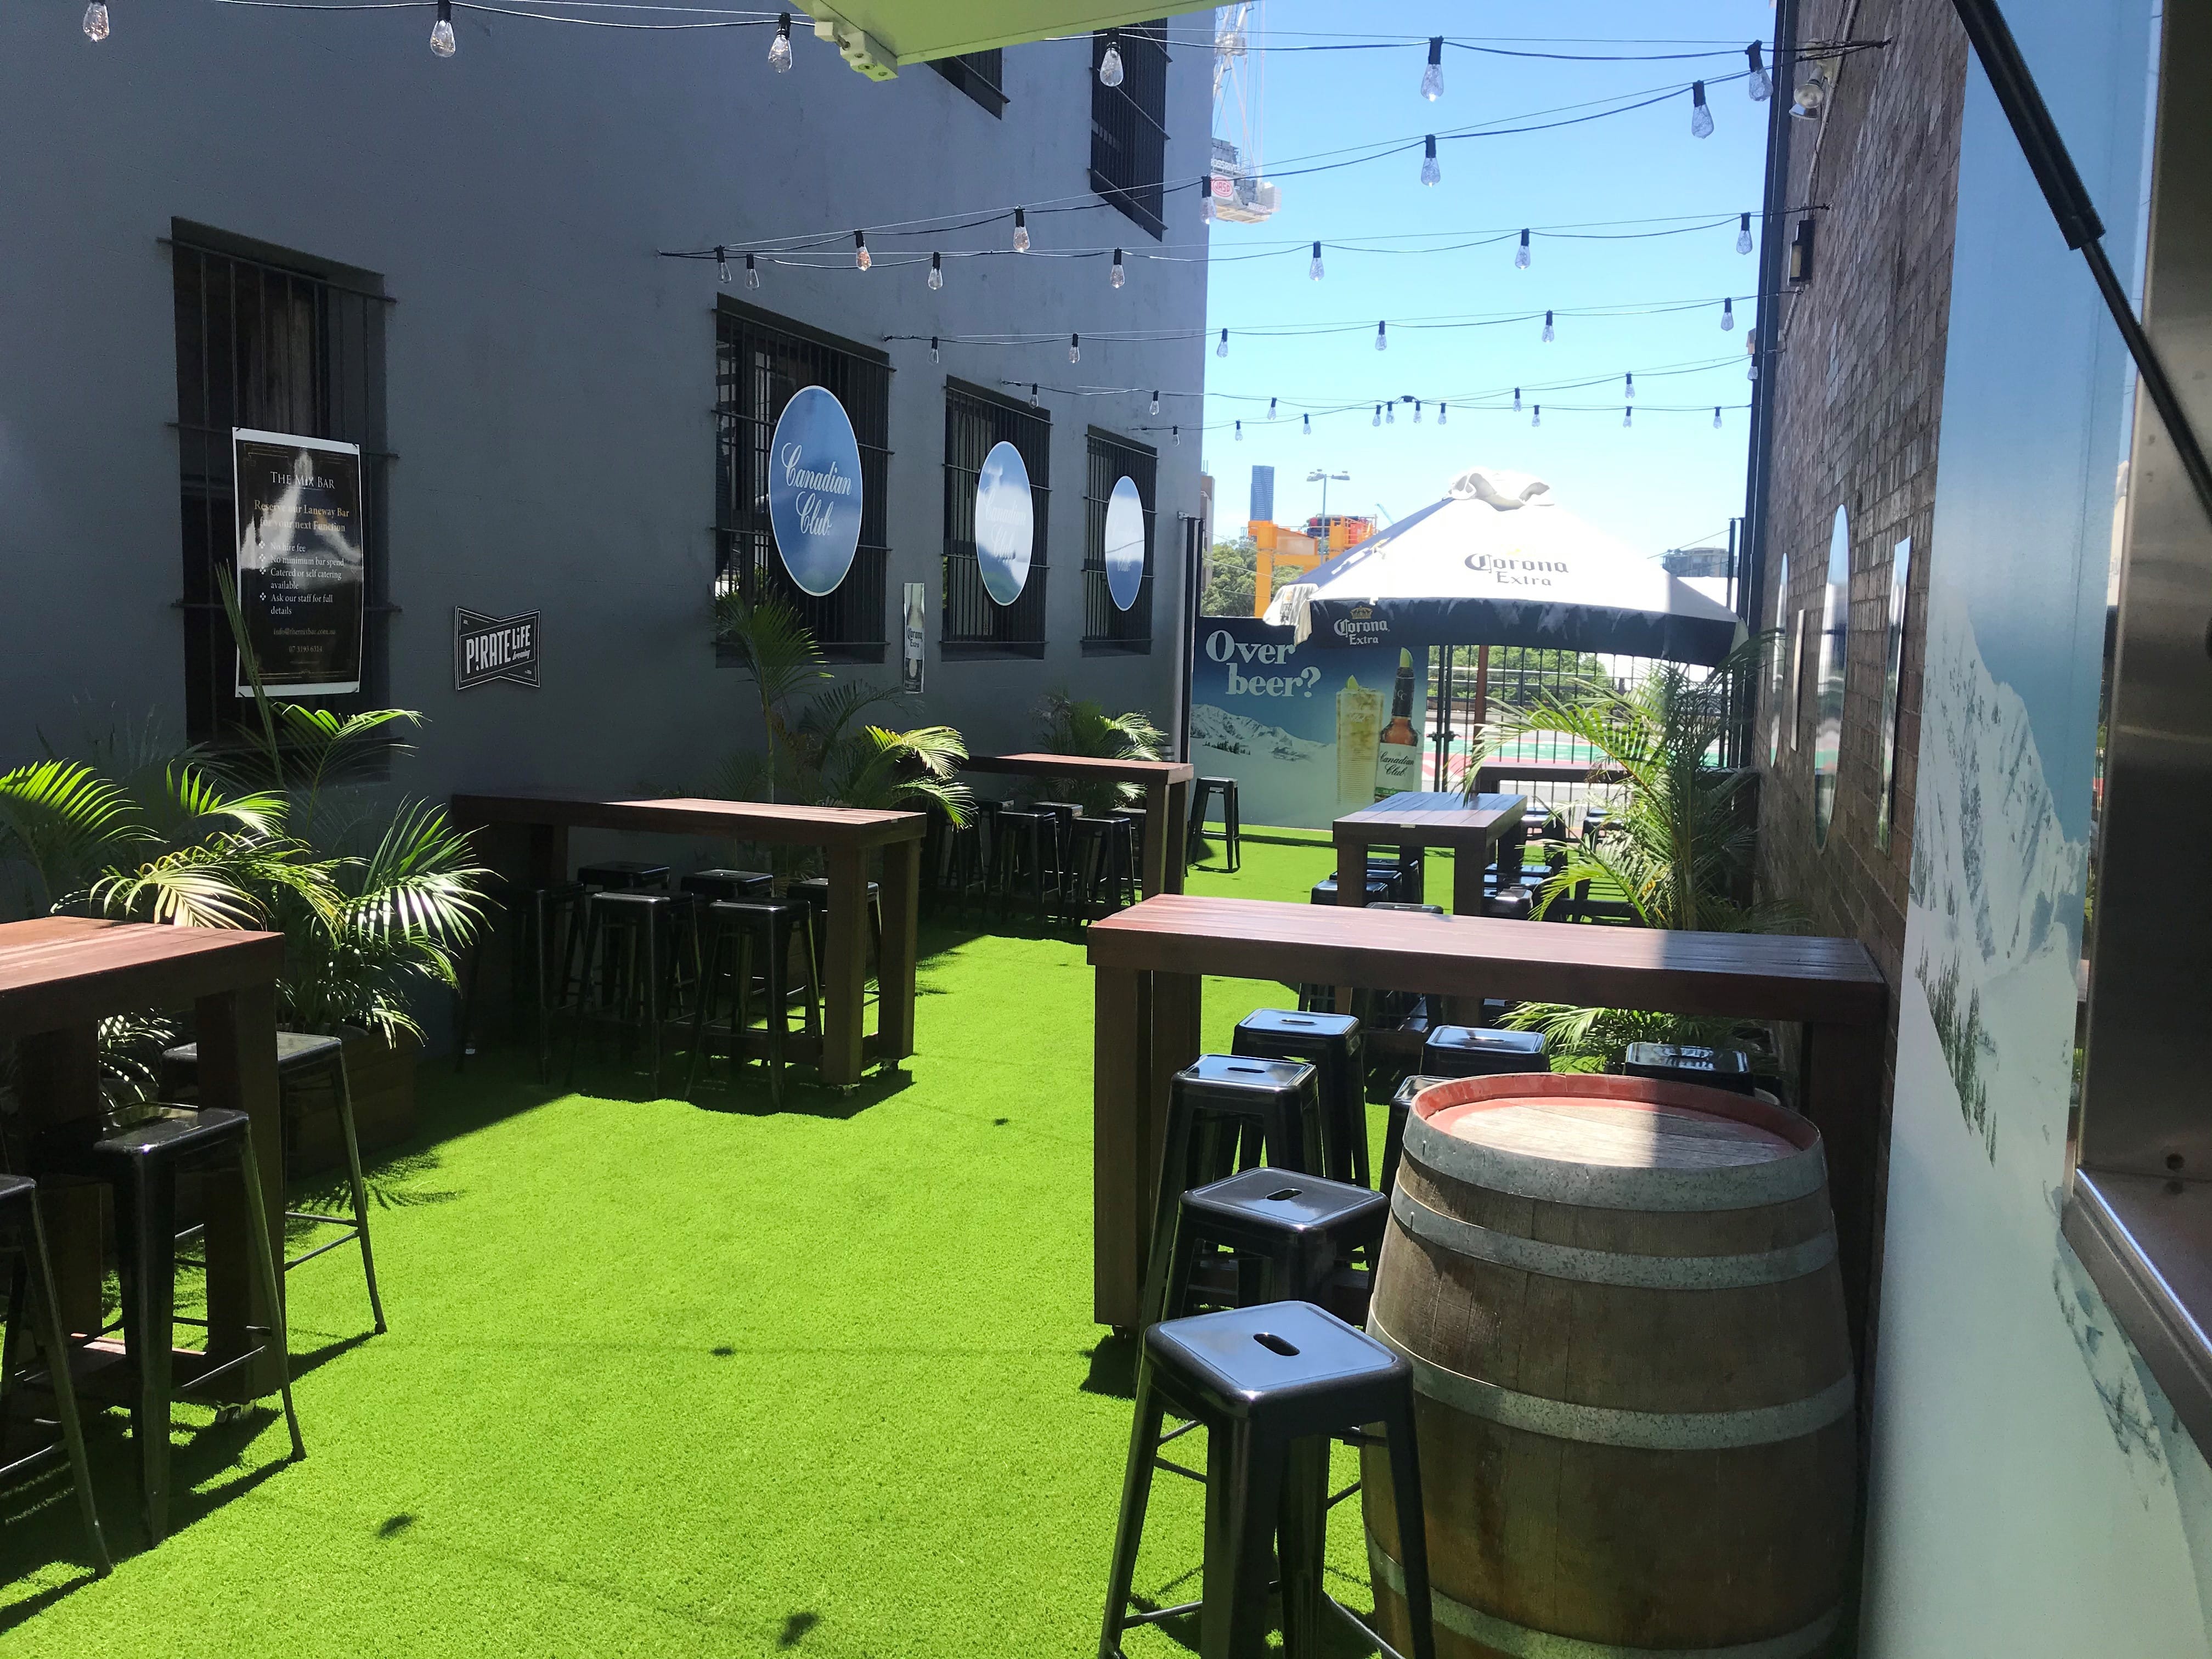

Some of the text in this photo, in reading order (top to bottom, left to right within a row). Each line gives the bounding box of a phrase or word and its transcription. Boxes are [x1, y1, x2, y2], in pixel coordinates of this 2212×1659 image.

[781, 442, 852, 495] Canadian
[270, 471, 335, 489] THE MIX BAR
[254, 499, 285, 512] Reserve
[304, 504, 336, 518] Laneway
[337, 507, 349, 517] Bar
[796, 491, 834, 535] Club
[295, 521, 311, 529] next
[313, 521, 346, 532] Function
[270, 542, 306, 552] No hire fee
[270, 555, 345, 568] No minimum bar spend
[1464, 553, 1569, 573] Corona
[270, 567, 296, 577] Catered
[306, 569, 317, 578] self
[318, 571, 342, 581] catering
[1496, 571, 1552, 586] Extra
[270, 580, 299, 590] available
[270, 594, 284, 602] Ask
[298, 594, 312, 603] staff
[313, 594, 322, 603] for
[323, 594, 333, 603] full
[270, 606, 292, 614] details
[1334, 618, 1388, 637] Corona
[1349, 634, 1379, 645] Extra
[1206, 630, 1296, 664] Over
[1225, 663, 1322, 698] beer?
[1380, 751, 1414, 765] Canadian
[1385, 763, 1408, 776] Club
